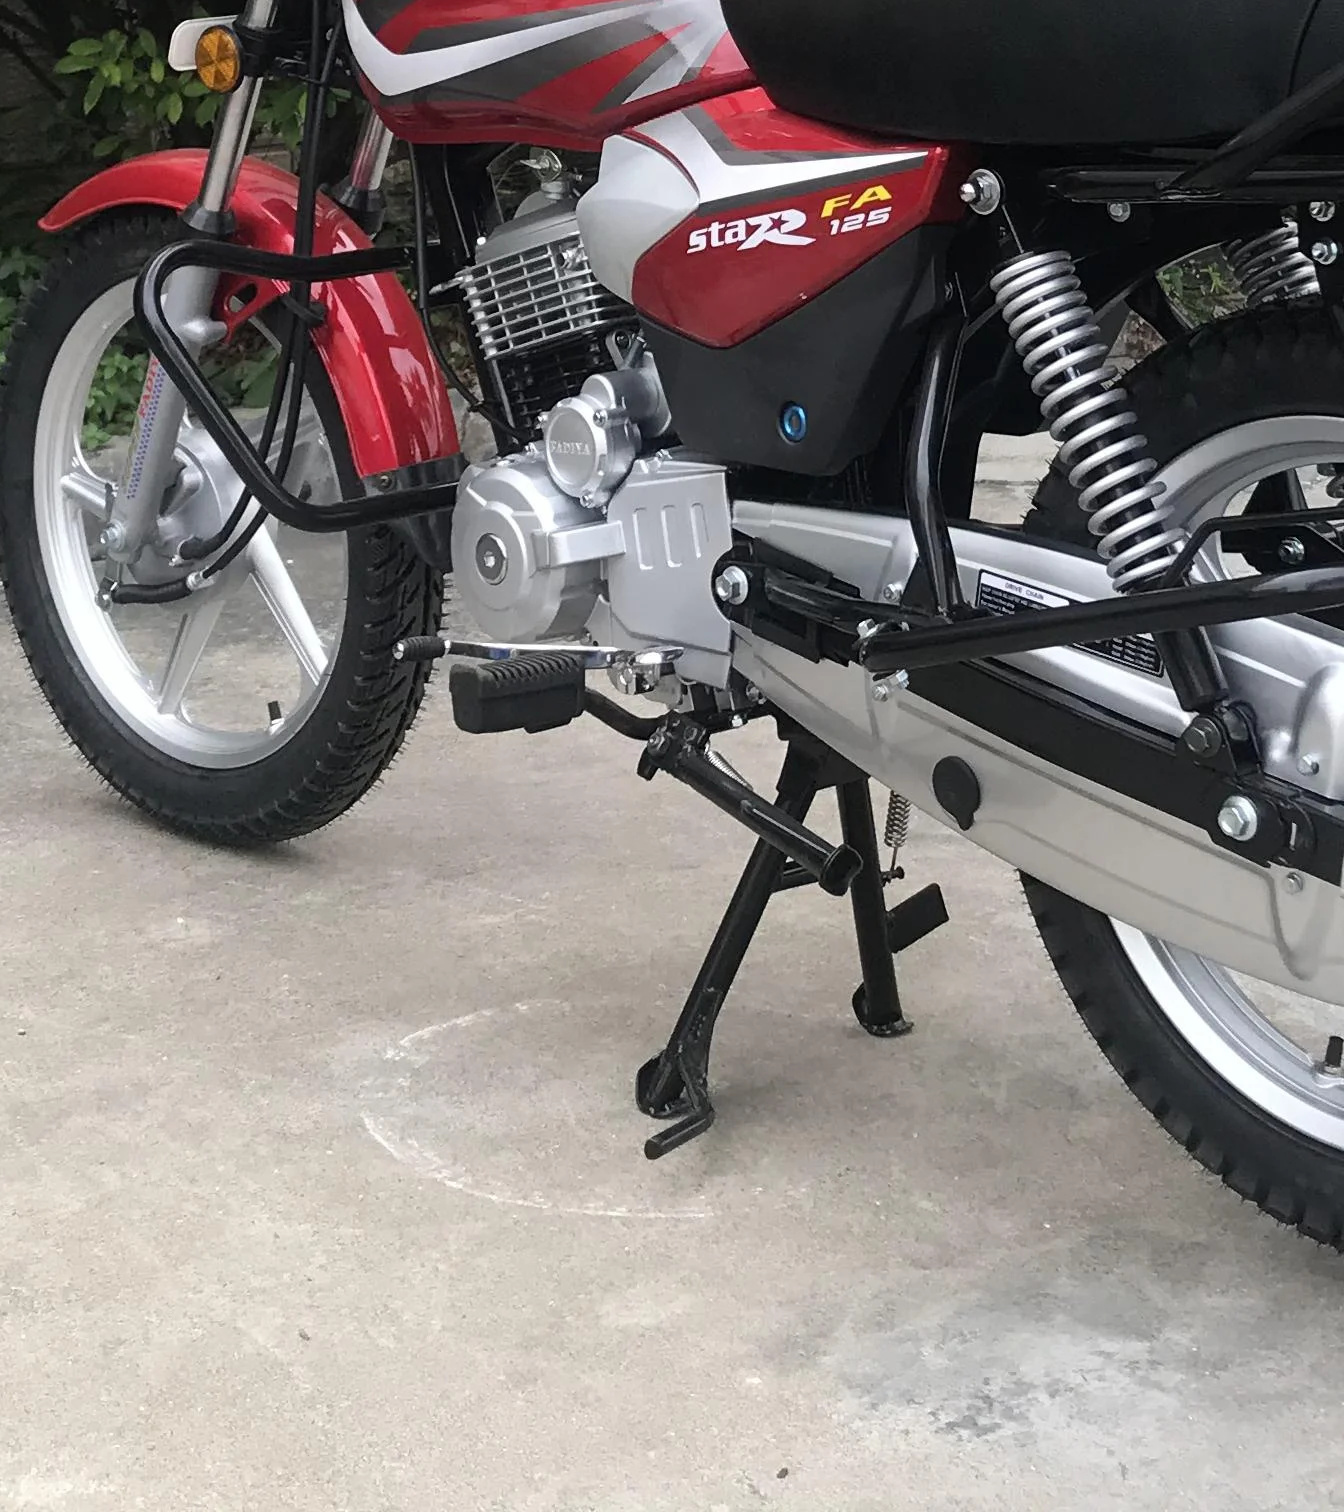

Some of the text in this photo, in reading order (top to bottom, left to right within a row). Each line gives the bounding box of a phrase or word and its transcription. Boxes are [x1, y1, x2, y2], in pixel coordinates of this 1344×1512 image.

[820, 184, 893, 219] FA
[829, 206, 893, 236] 125
[549, 439, 592, 456] FADIYA
